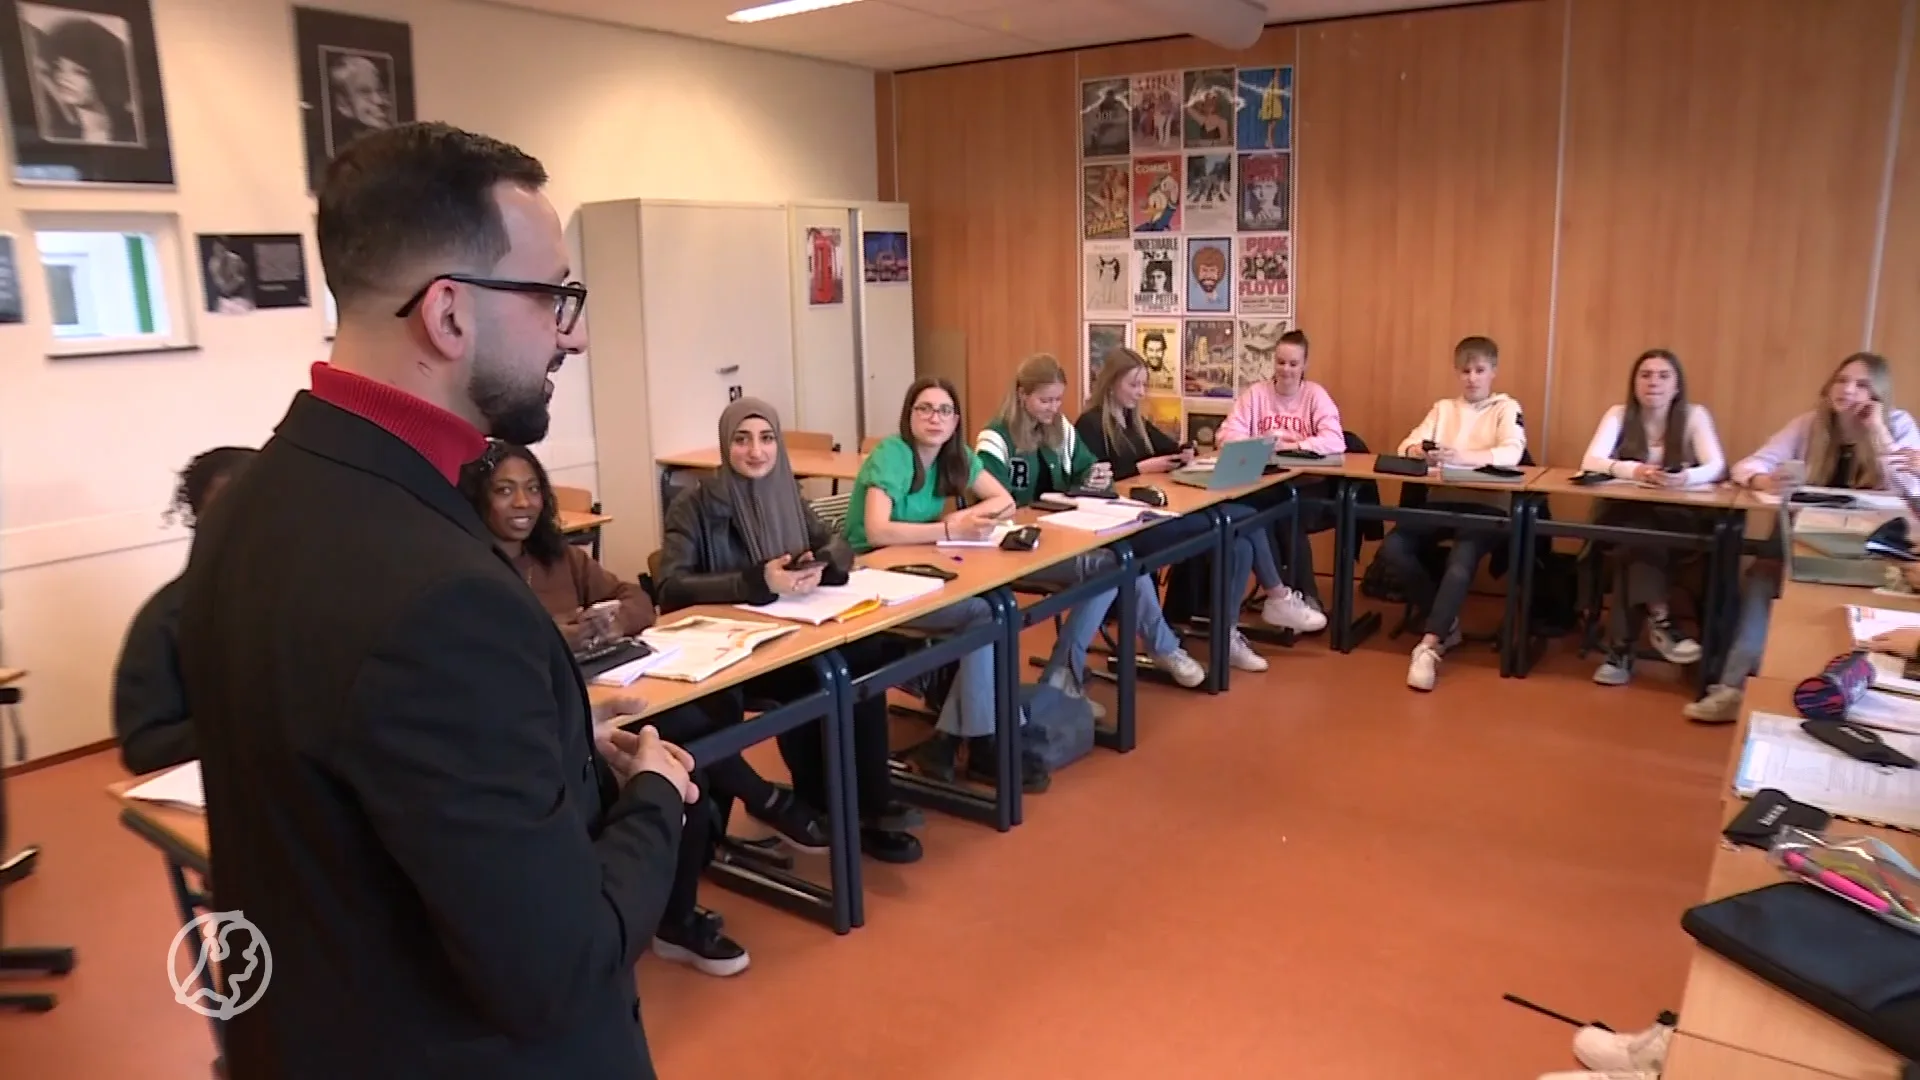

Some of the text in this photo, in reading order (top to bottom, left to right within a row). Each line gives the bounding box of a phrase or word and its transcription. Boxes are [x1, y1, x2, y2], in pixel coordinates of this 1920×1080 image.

[1246, 236, 1288, 252] PINK
[1239, 280, 1288, 296] FLOYD
[1010, 457, 1029, 490] R
